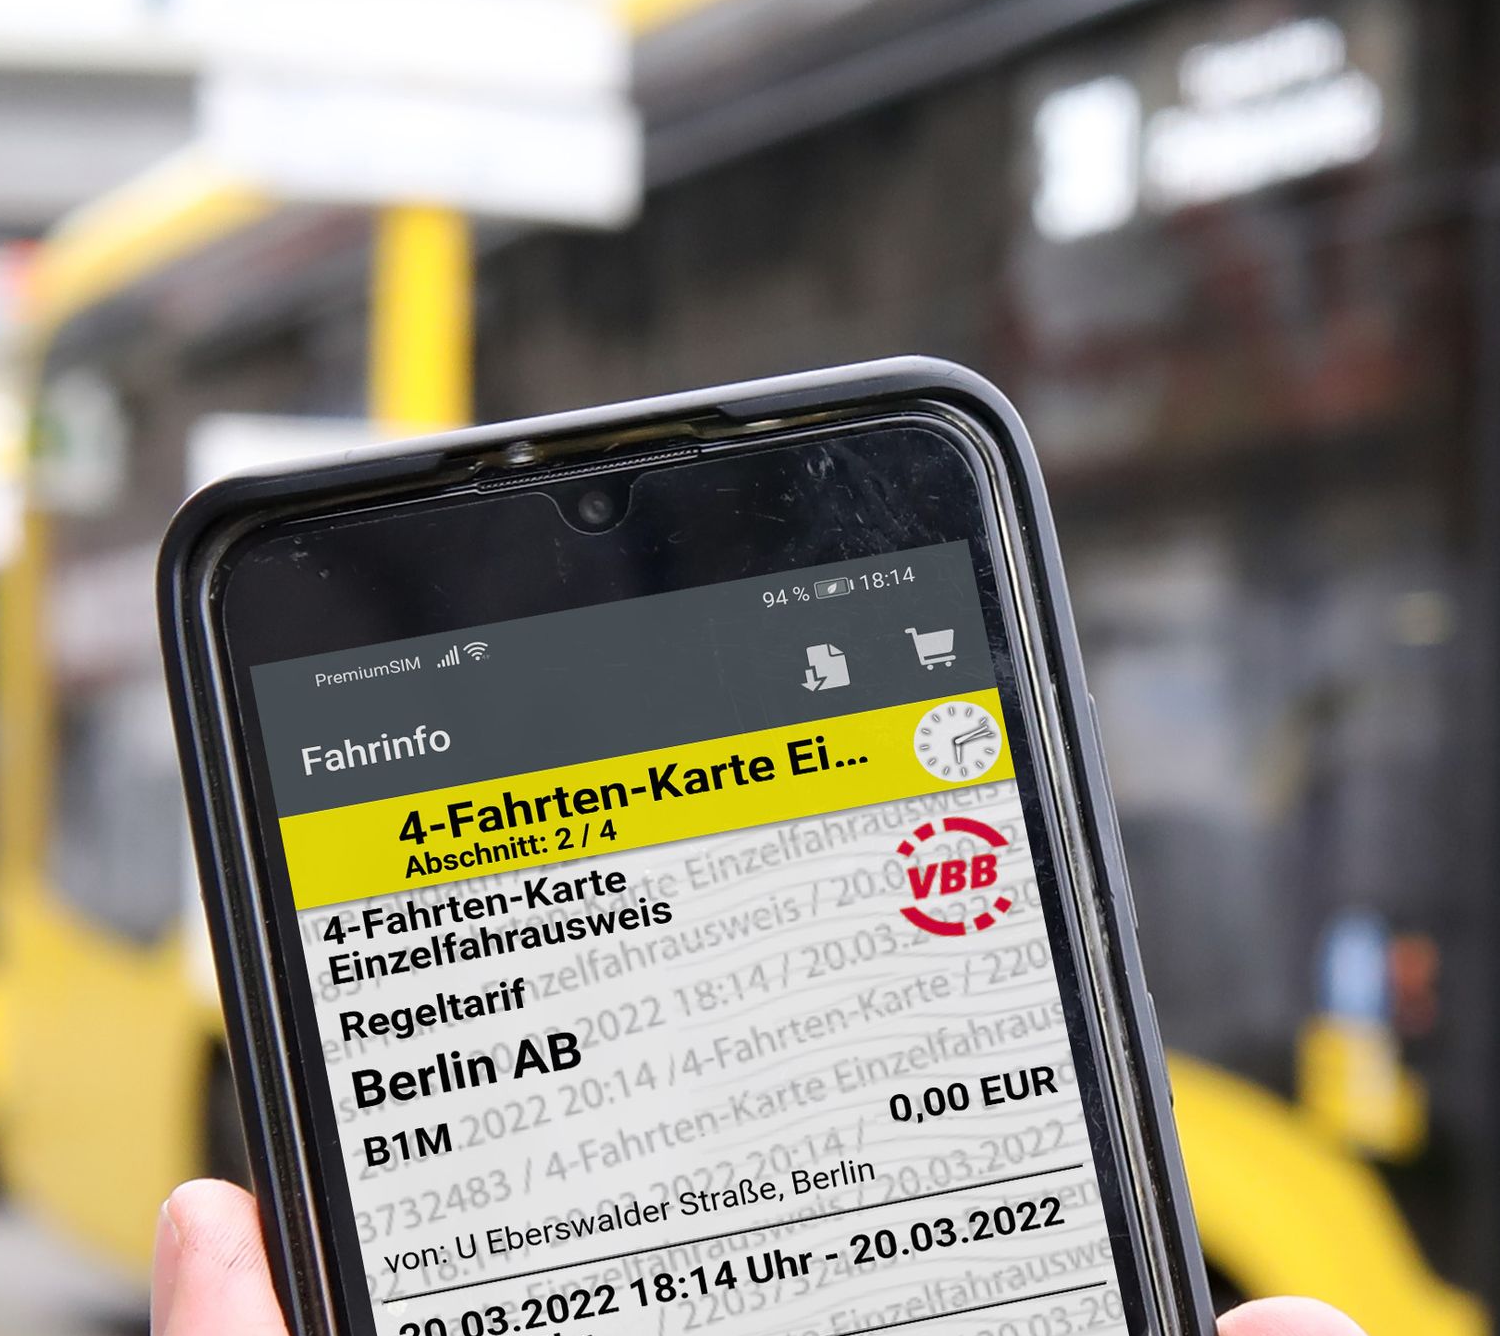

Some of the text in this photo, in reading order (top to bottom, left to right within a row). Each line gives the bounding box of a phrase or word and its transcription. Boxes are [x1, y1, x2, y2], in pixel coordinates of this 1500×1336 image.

[761, 586, 790, 608] 94
[859, 566, 916, 592] 18:14
[314, 656, 421, 687] PremiumSIM
[301, 724, 451, 776] Fahrinfo
[398, 754, 775, 845] 4-Fahrten-Karte
[404, 834, 550, 879] Abschnitt:
[555, 827, 576, 852] 2
[599, 818, 618, 842] 4
[907, 853, 998, 900] VBB
[323, 869, 627, 945] 4-Fahrten-Karte
[328, 901, 673, 985] Einzelfahrausweis
[338, 976, 526, 1042] Regeltarif
[351, 1050, 497, 1109] Berlin
[512, 1030, 582, 1080] AB
[889, 1065, 1059, 1123] 0,00 EUR
[362, 1122, 453, 1167] B1M
[542, 1076, 825, 1185] 4-Fahrten-Karte
[383, 1159, 876, 1273] von: U Eberswalder Straße, Berlin
[629, 1259, 738, 1307] 18:14
[745, 1248, 813, 1284] Uhr
[849, 1196, 1065, 1265] 20.03.2022
